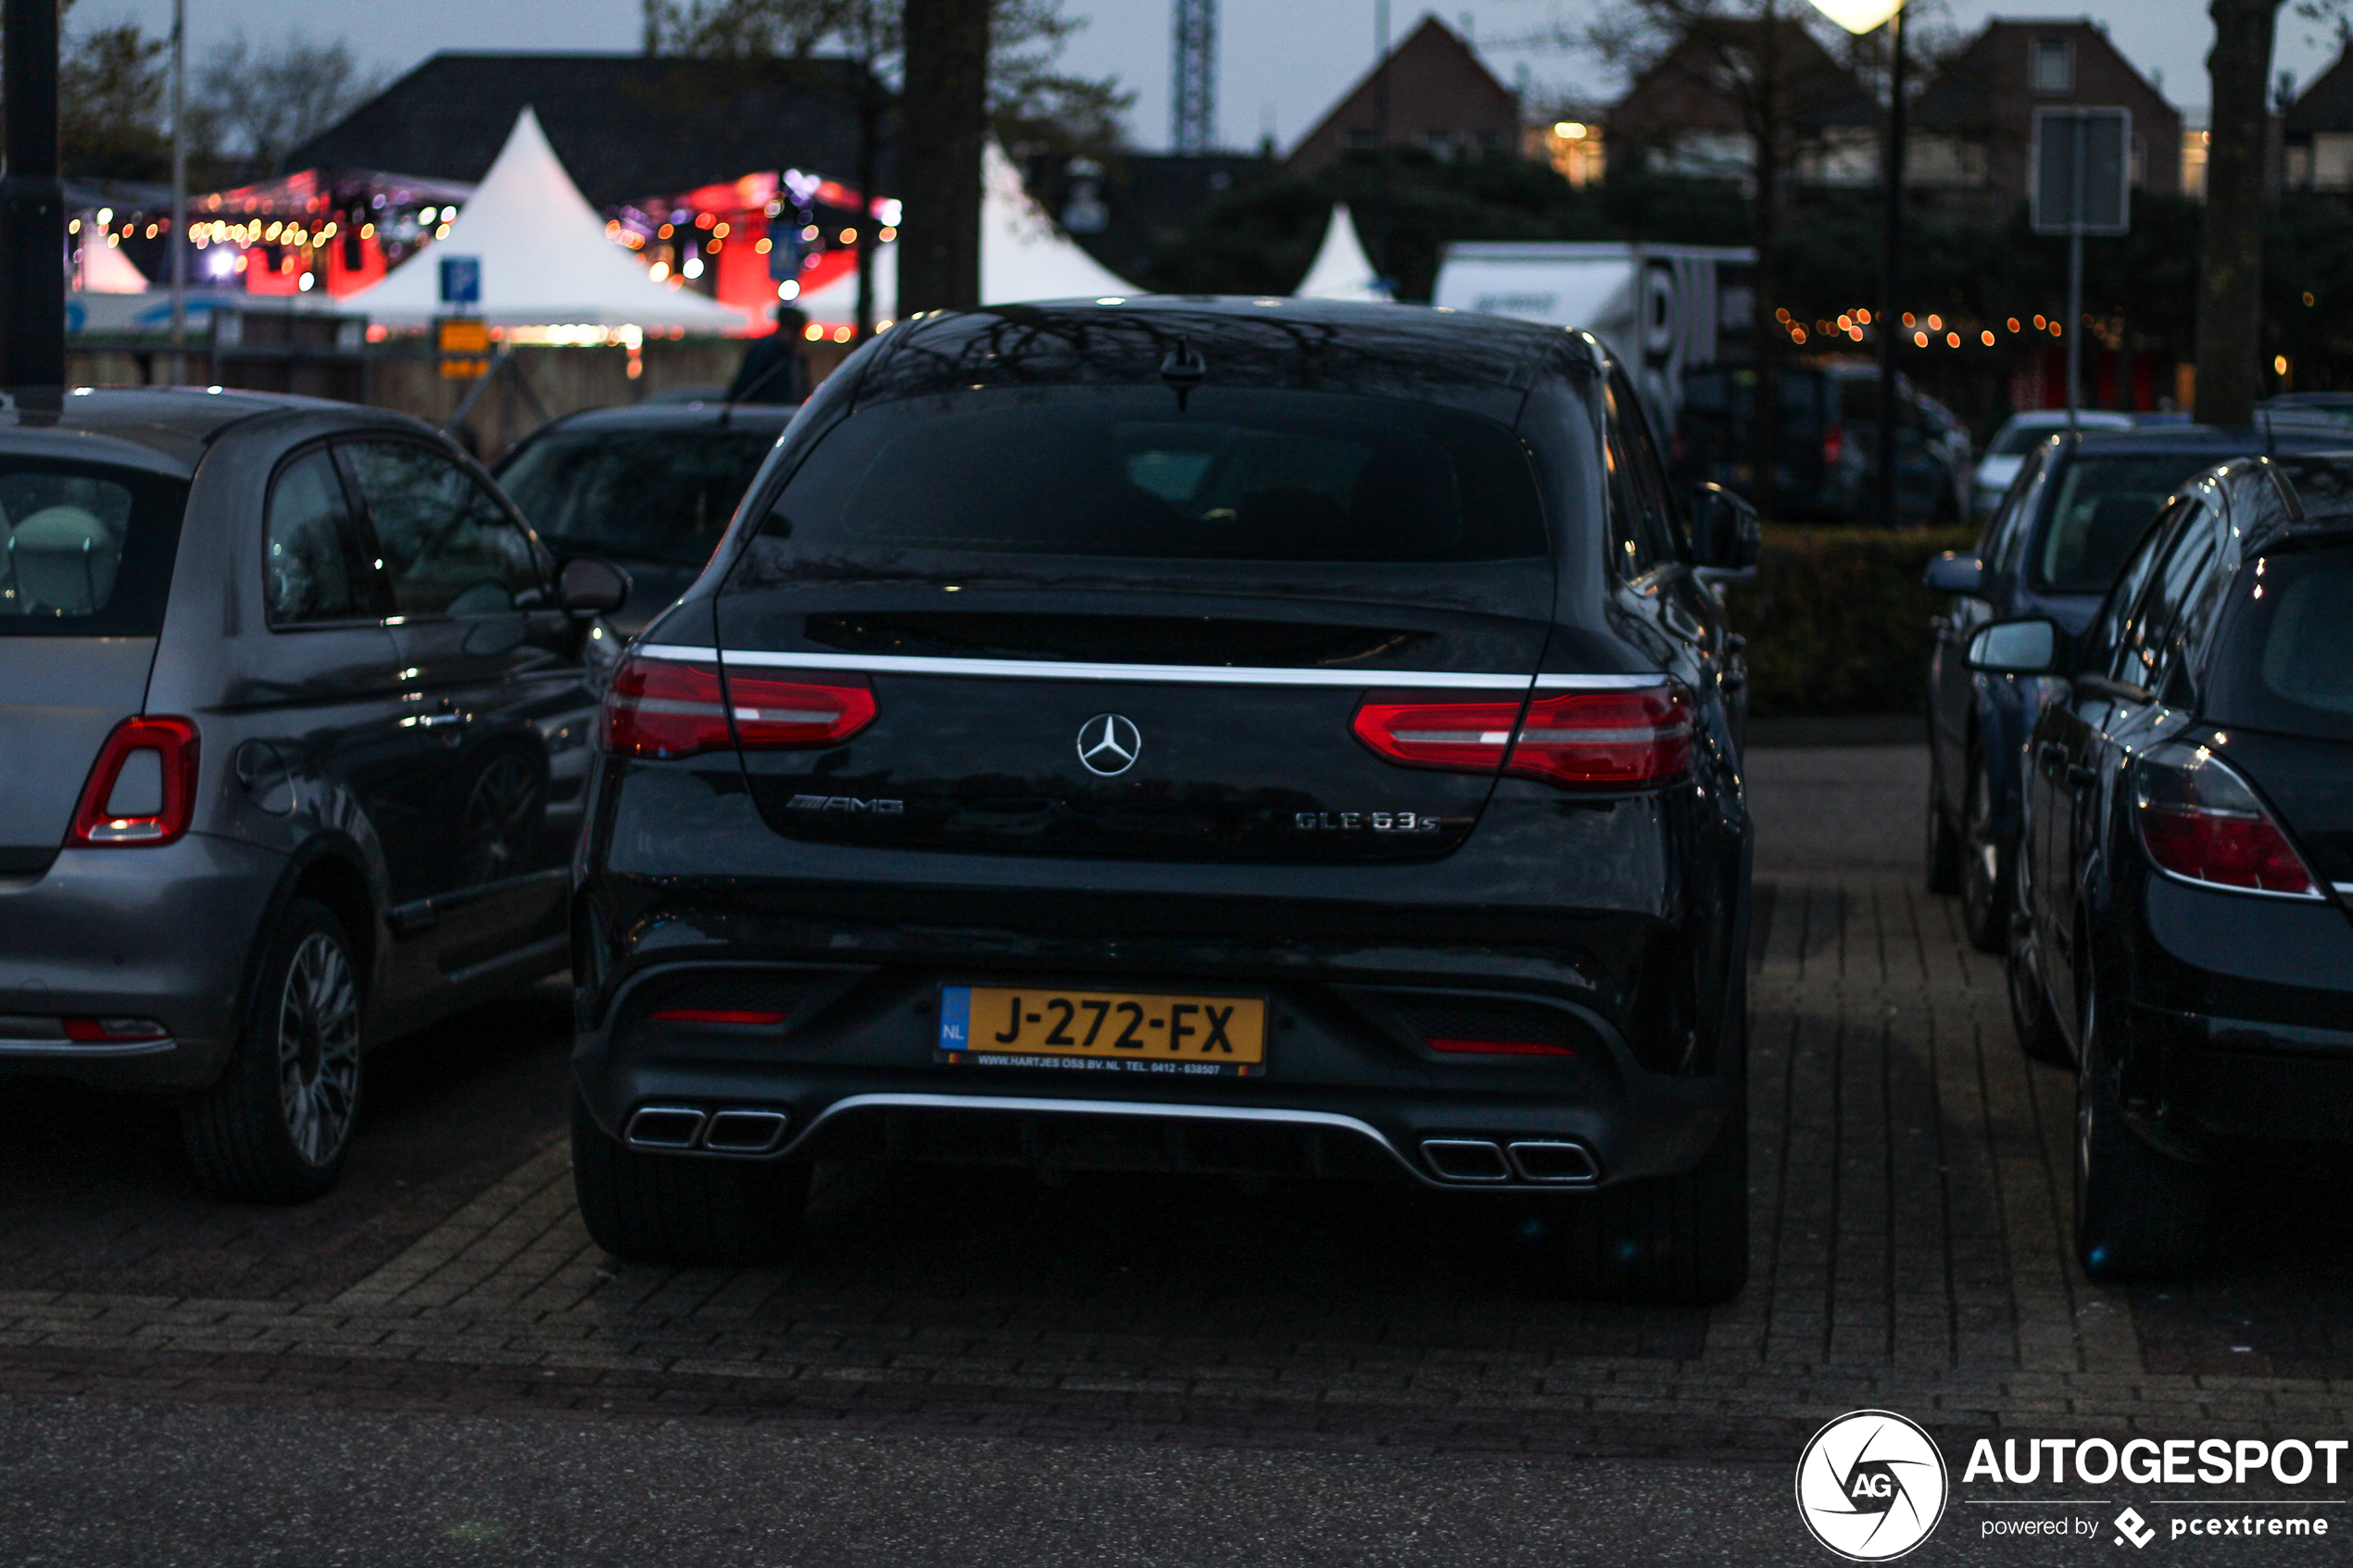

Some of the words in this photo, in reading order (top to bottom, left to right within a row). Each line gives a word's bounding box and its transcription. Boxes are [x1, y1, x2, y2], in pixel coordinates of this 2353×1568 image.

[449, 262, 476, 296] P
[823, 796, 904, 814] AMG
[1295, 811, 1362, 831] GLE
[943, 1024, 964, 1040] NL
[994, 997, 1235, 1054] J-272-FX
[1151, 1061, 1176, 1073] 0412
[1184, 1063, 1221, 1074] 638507
